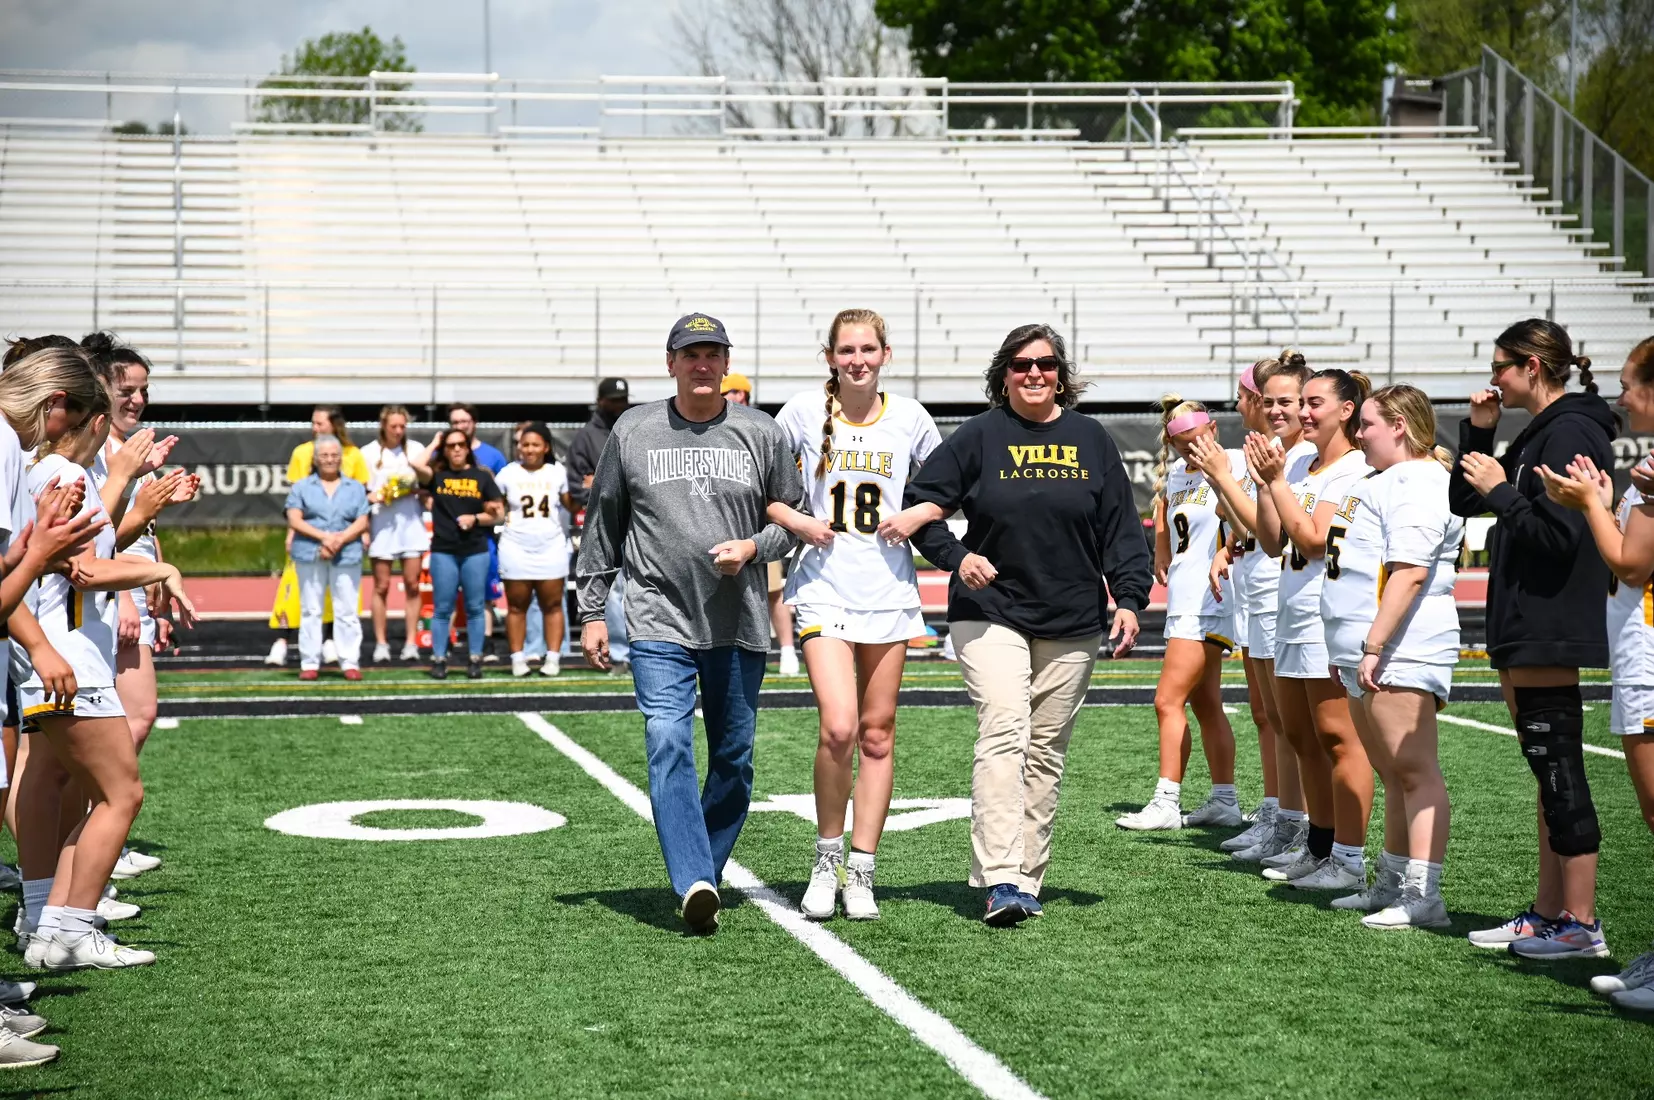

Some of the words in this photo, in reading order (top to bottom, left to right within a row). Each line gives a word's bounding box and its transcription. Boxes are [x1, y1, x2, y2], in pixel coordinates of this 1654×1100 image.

[647, 447, 752, 487] MILLERSVILLE
[1007, 444, 1080, 469] VILLE
[999, 468, 1090, 480] LACROSSE
[520, 494, 550, 518] 24
[828, 480, 883, 535] 18
[1173, 512, 1190, 554] 9
